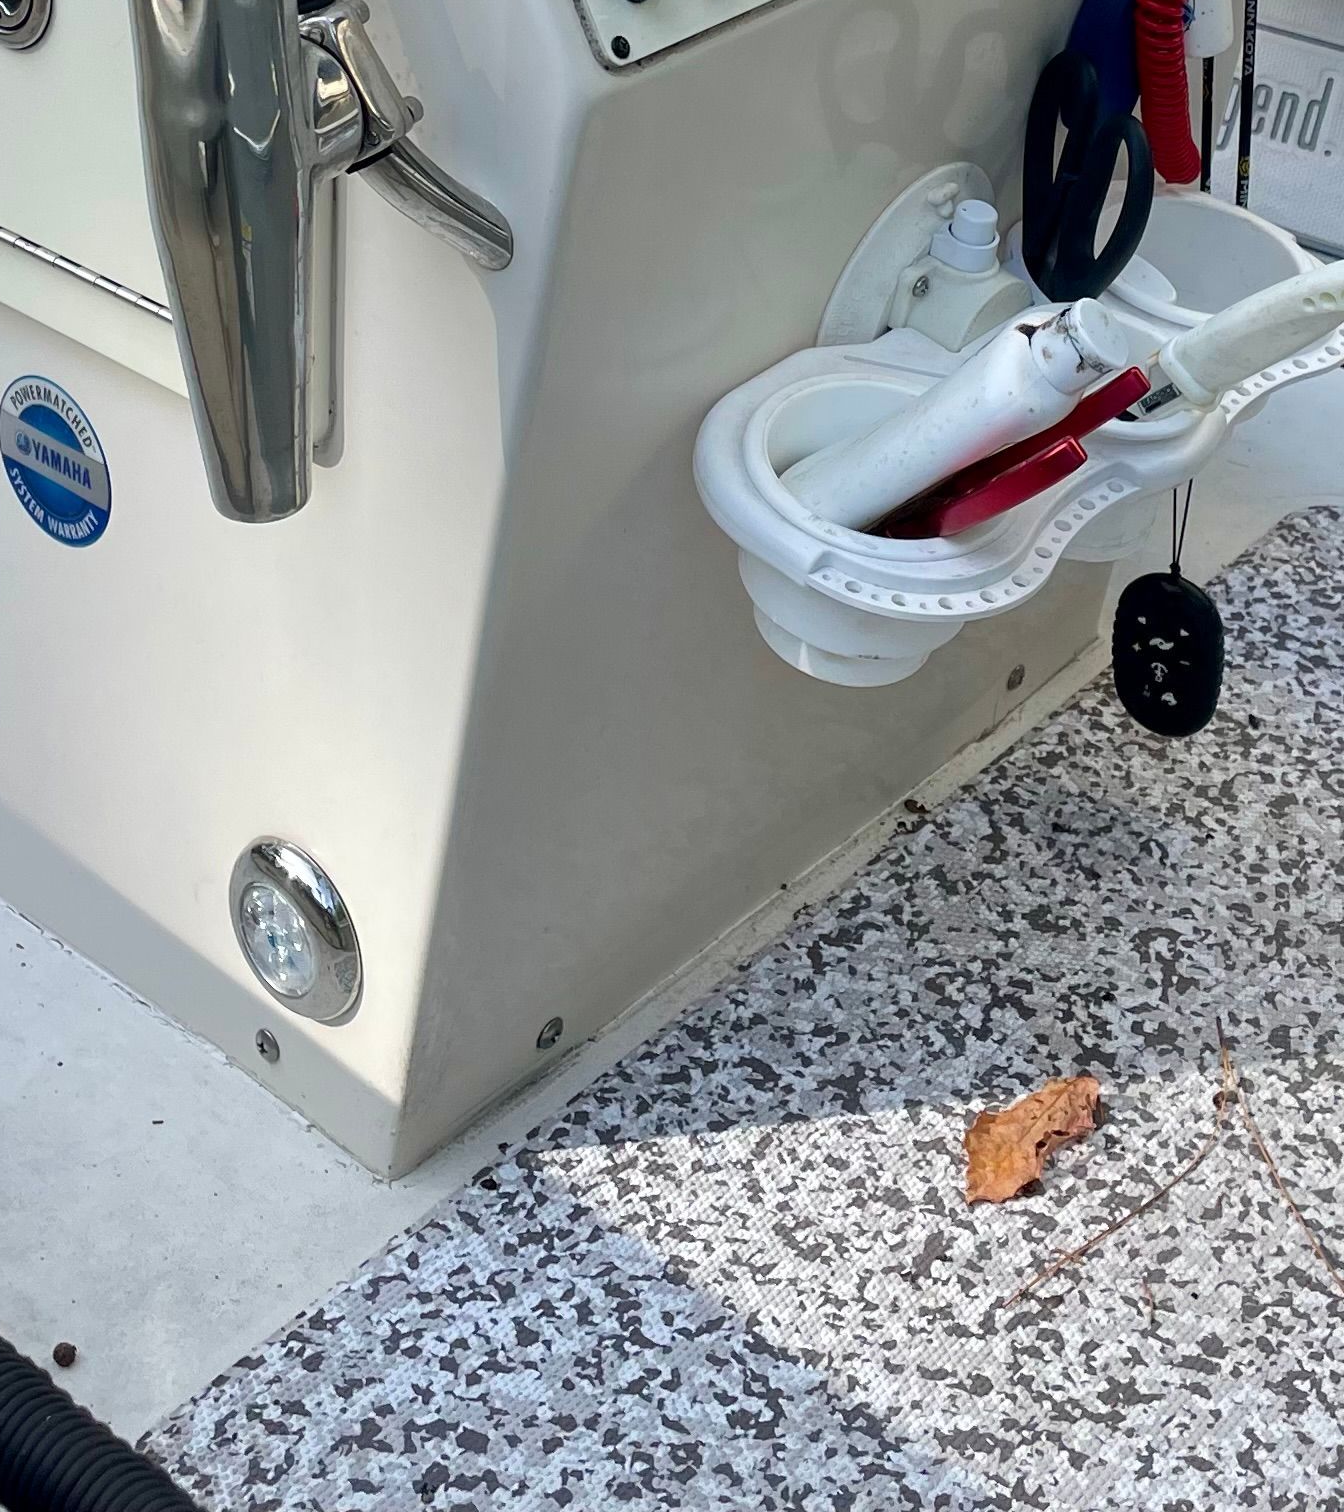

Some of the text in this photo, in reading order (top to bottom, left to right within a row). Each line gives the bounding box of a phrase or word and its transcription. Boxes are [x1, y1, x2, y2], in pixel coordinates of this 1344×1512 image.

[1244, 29, 1255, 77] KOTA
[10, 383, 92, 449] POWERMATCHED
[31, 437, 92, 490] YAMAHA
[9, 466, 100, 540] SYSTEM WARRANTY
